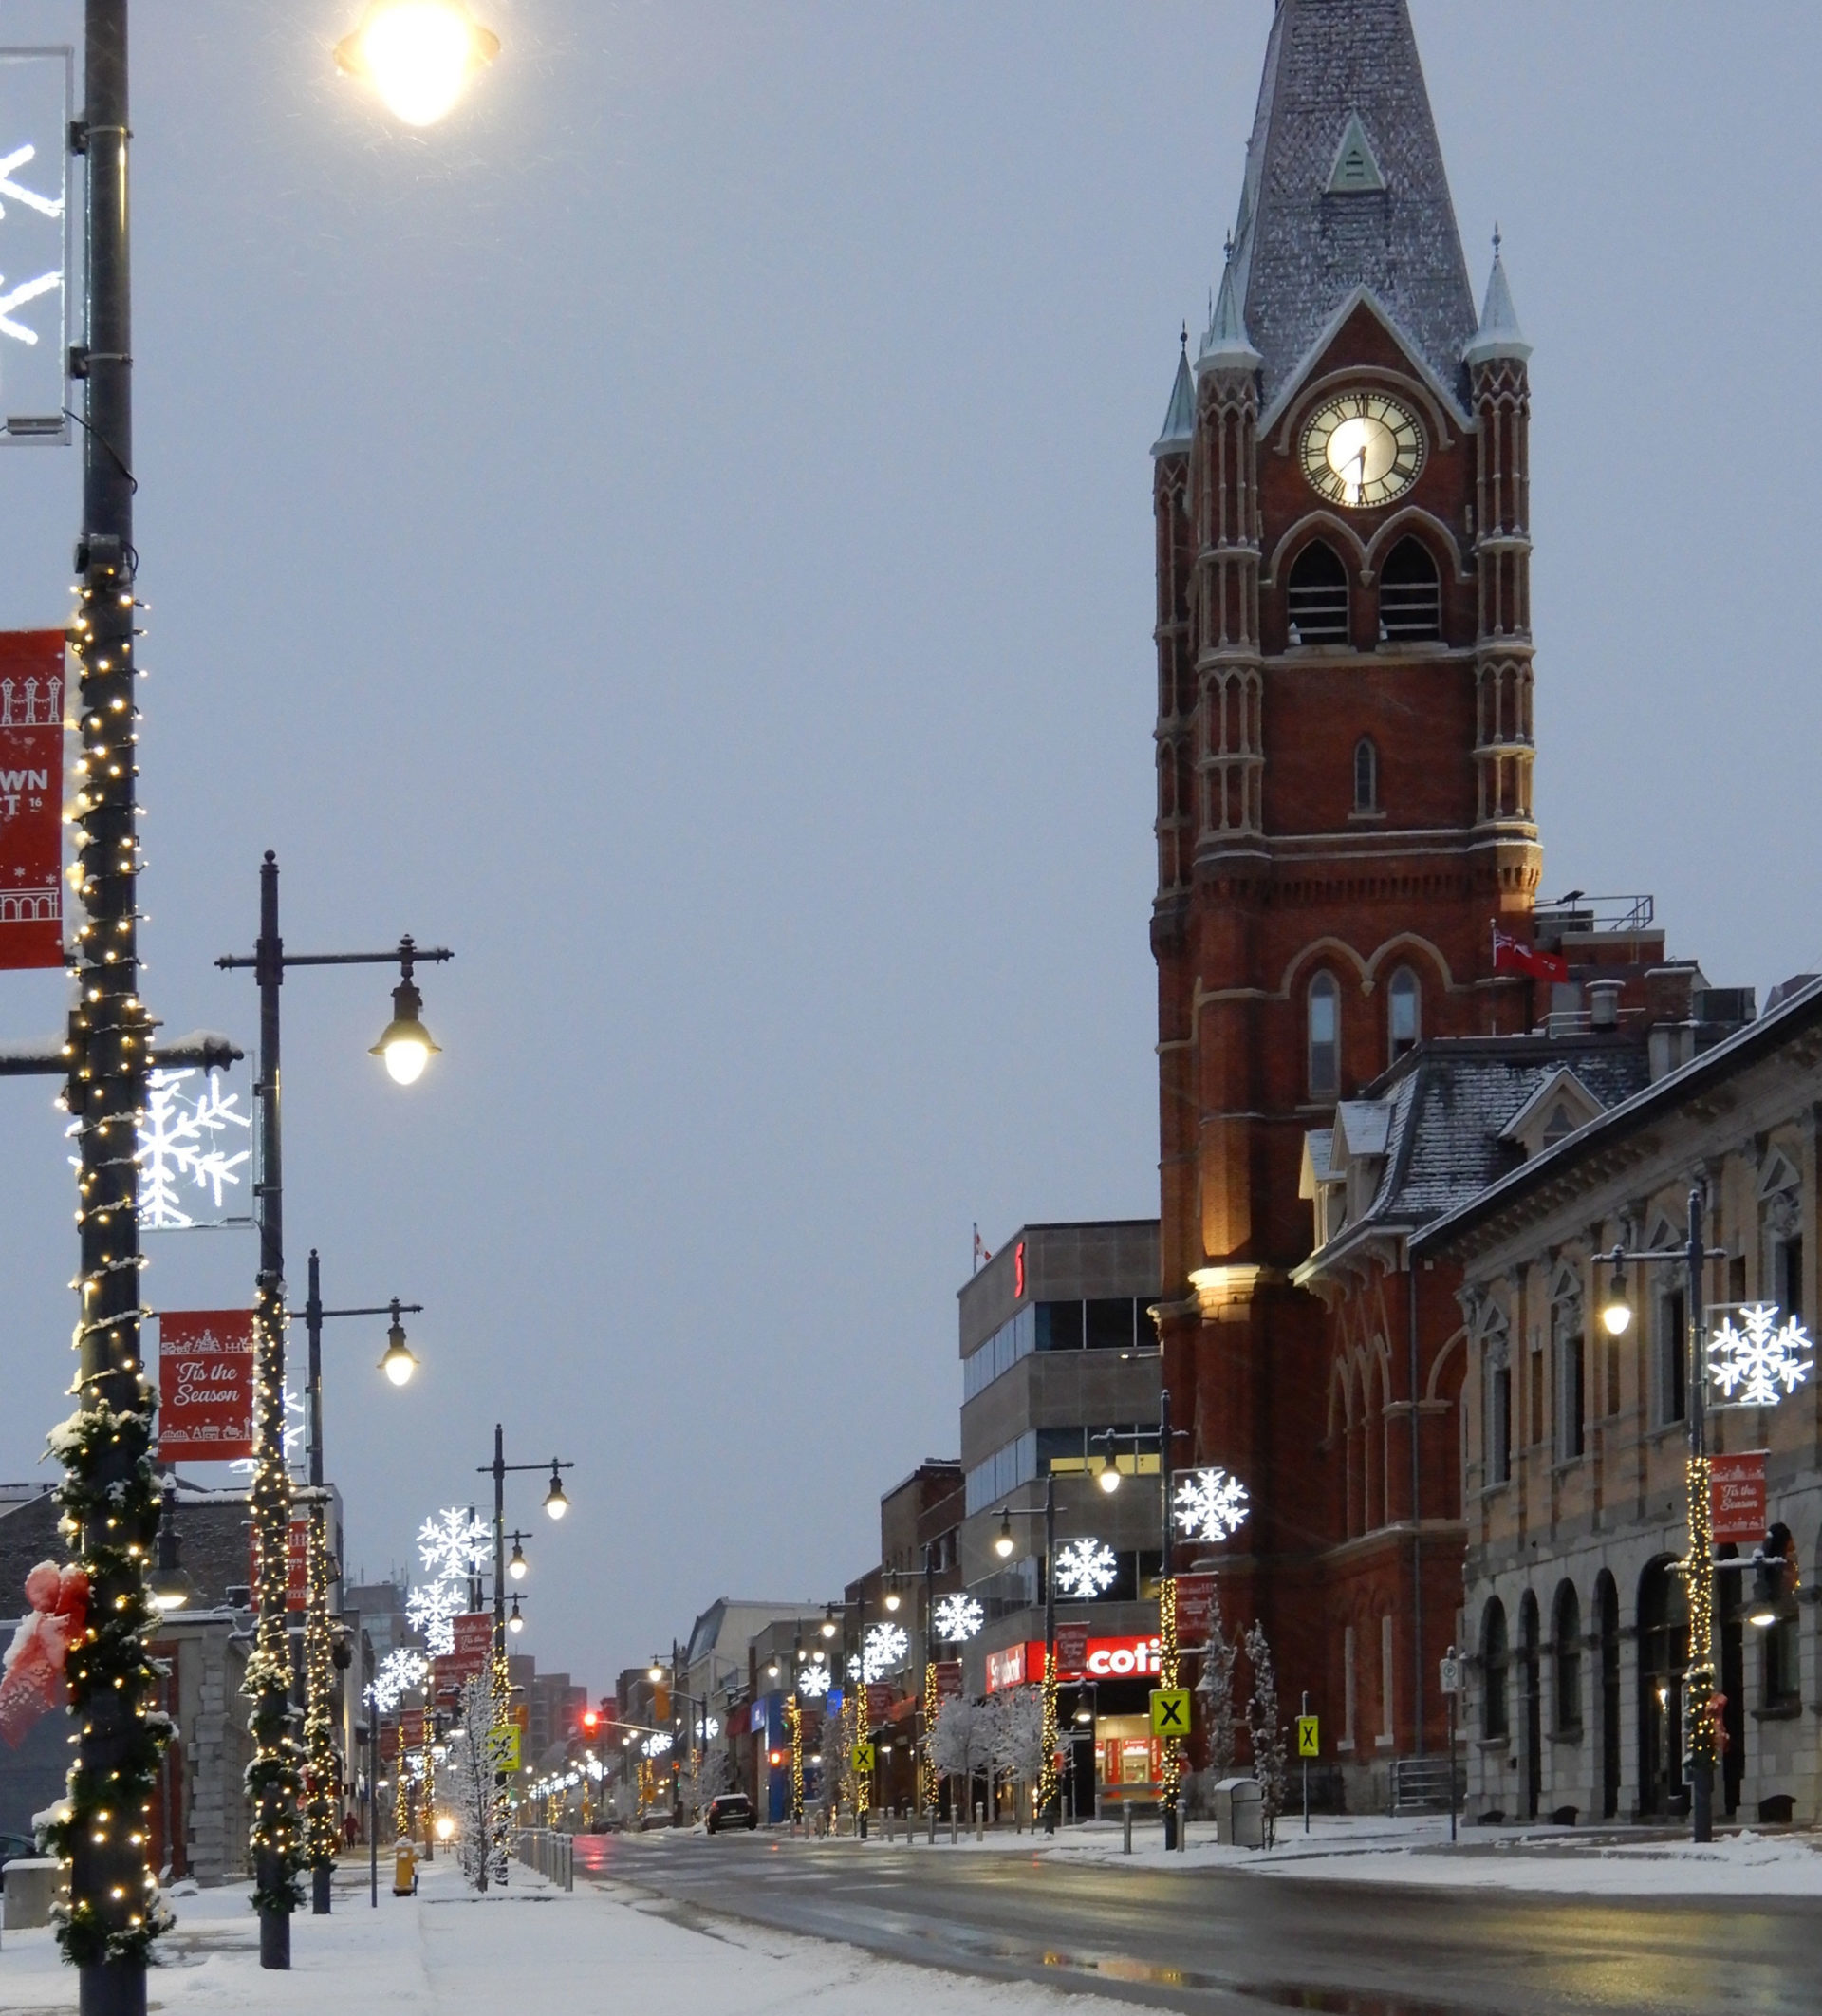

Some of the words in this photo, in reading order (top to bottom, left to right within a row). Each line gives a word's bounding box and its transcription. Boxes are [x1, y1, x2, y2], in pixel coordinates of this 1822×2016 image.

[211, 1363, 237, 1381] the
[174, 1384, 240, 1406] Season
[1740, 1484, 1757, 1496] the
[1720, 1497, 1758, 1511] Season
[1160, 1700, 1183, 1726] X
[1303, 1726, 1314, 1747] X
[857, 1750, 869, 1765] X
